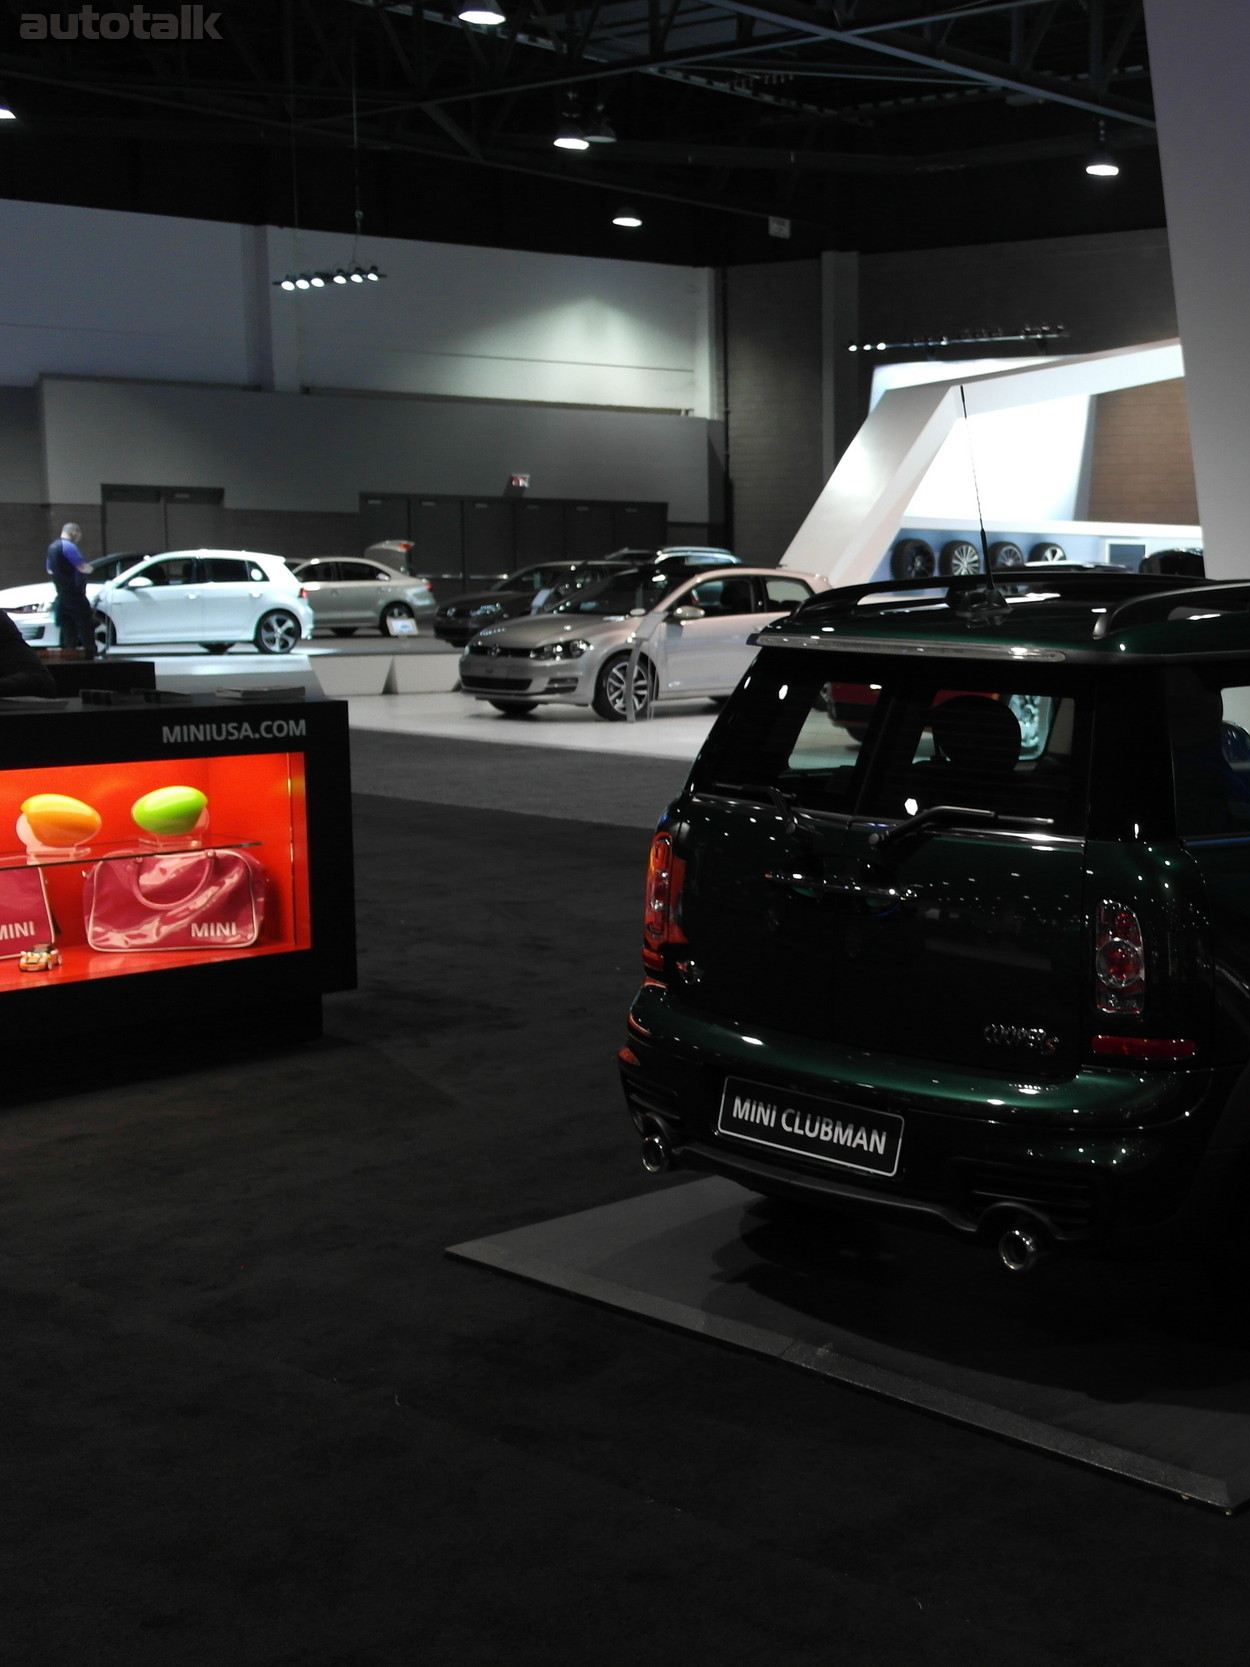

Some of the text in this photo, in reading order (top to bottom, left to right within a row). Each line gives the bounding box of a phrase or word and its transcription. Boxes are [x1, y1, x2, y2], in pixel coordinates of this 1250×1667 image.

[162, 719, 306, 743] MINIUSA.COM
[191, 922, 237, 937] MINI
[732, 1095, 887, 1155] MINI CLUBMAN
